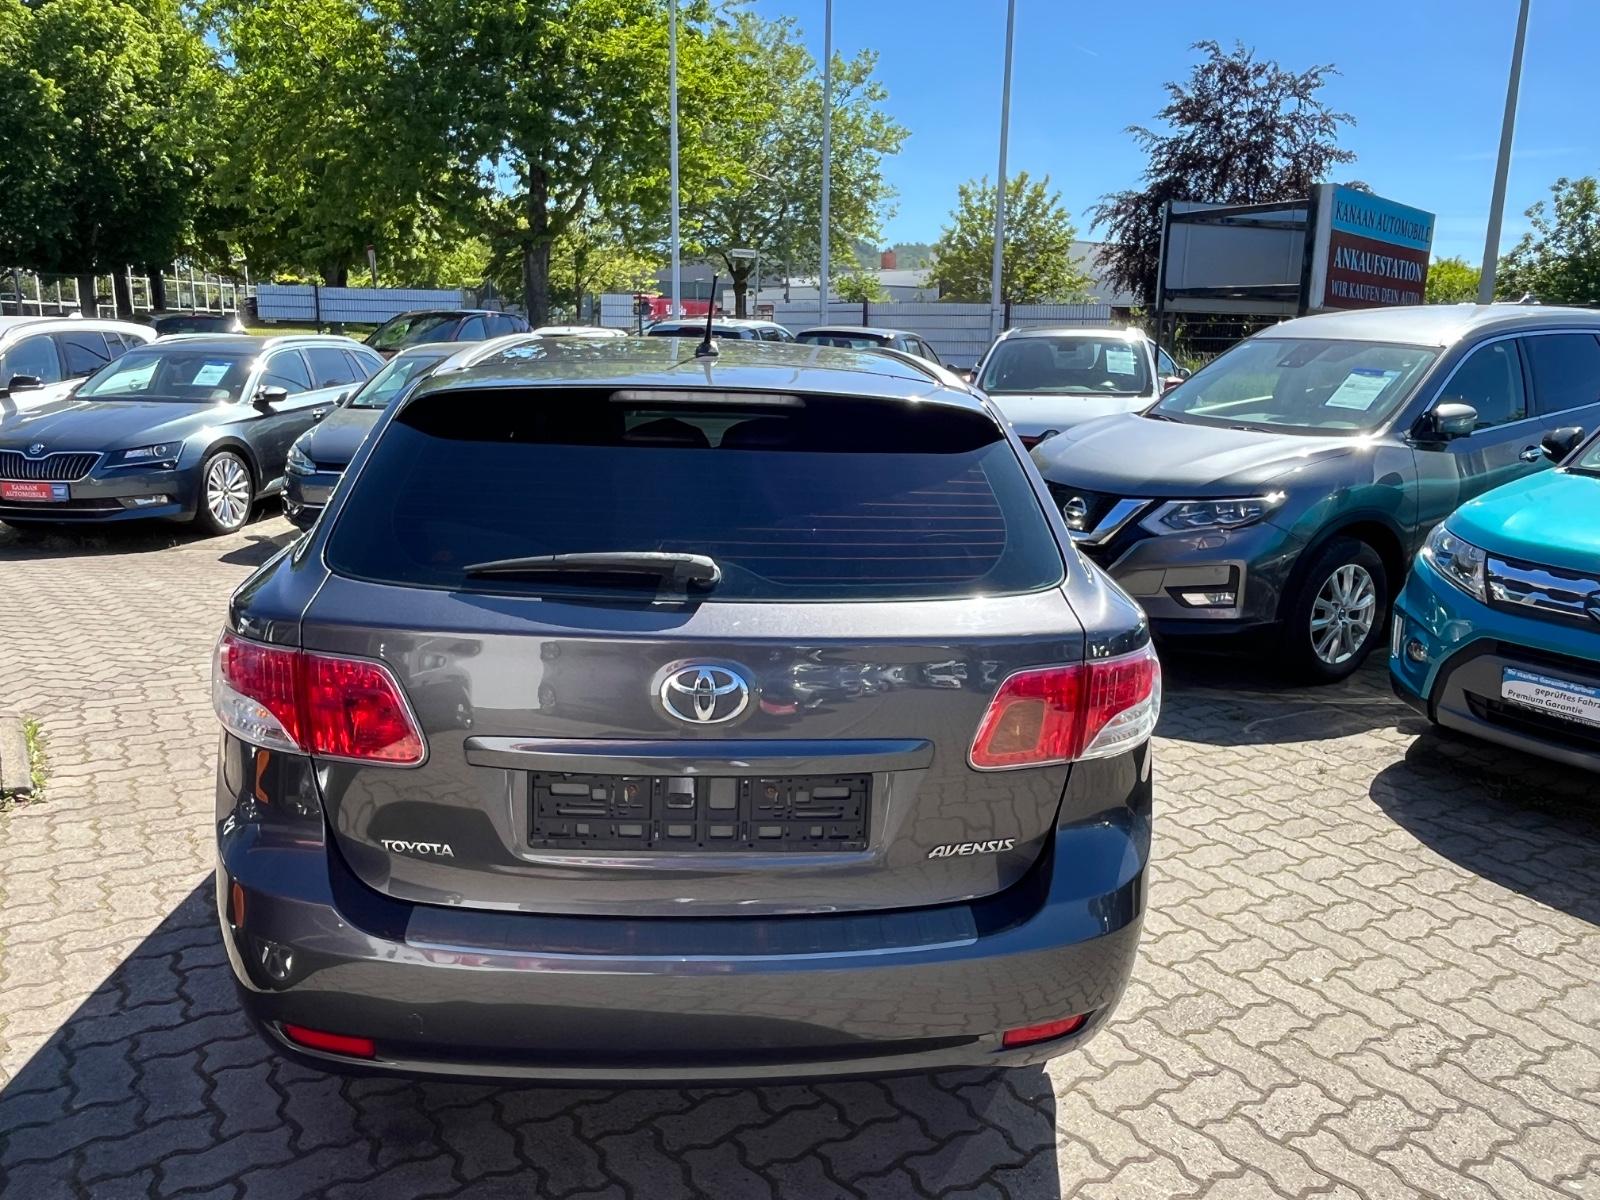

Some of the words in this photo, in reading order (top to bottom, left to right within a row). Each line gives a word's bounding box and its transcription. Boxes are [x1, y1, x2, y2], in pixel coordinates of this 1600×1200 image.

[1336, 201, 1376, 229] KANAAN
[1377, 214, 1431, 243] AUTOMOBILE
[1333, 246, 1424, 282] ANKAUFSTATION
[1331, 280, 1348, 298] WIR
[1349, 283, 1380, 301] KAUFEN
[1381, 288, 1399, 305] DEIN
[1507, 688, 1544, 705] Premium
[1545, 699, 1584, 714] Garantie
[1535, 687, 1576, 703] geprüftes
[381, 839, 455, 857] TOYOTA
[928, 838, 1016, 858] AVENSIS
